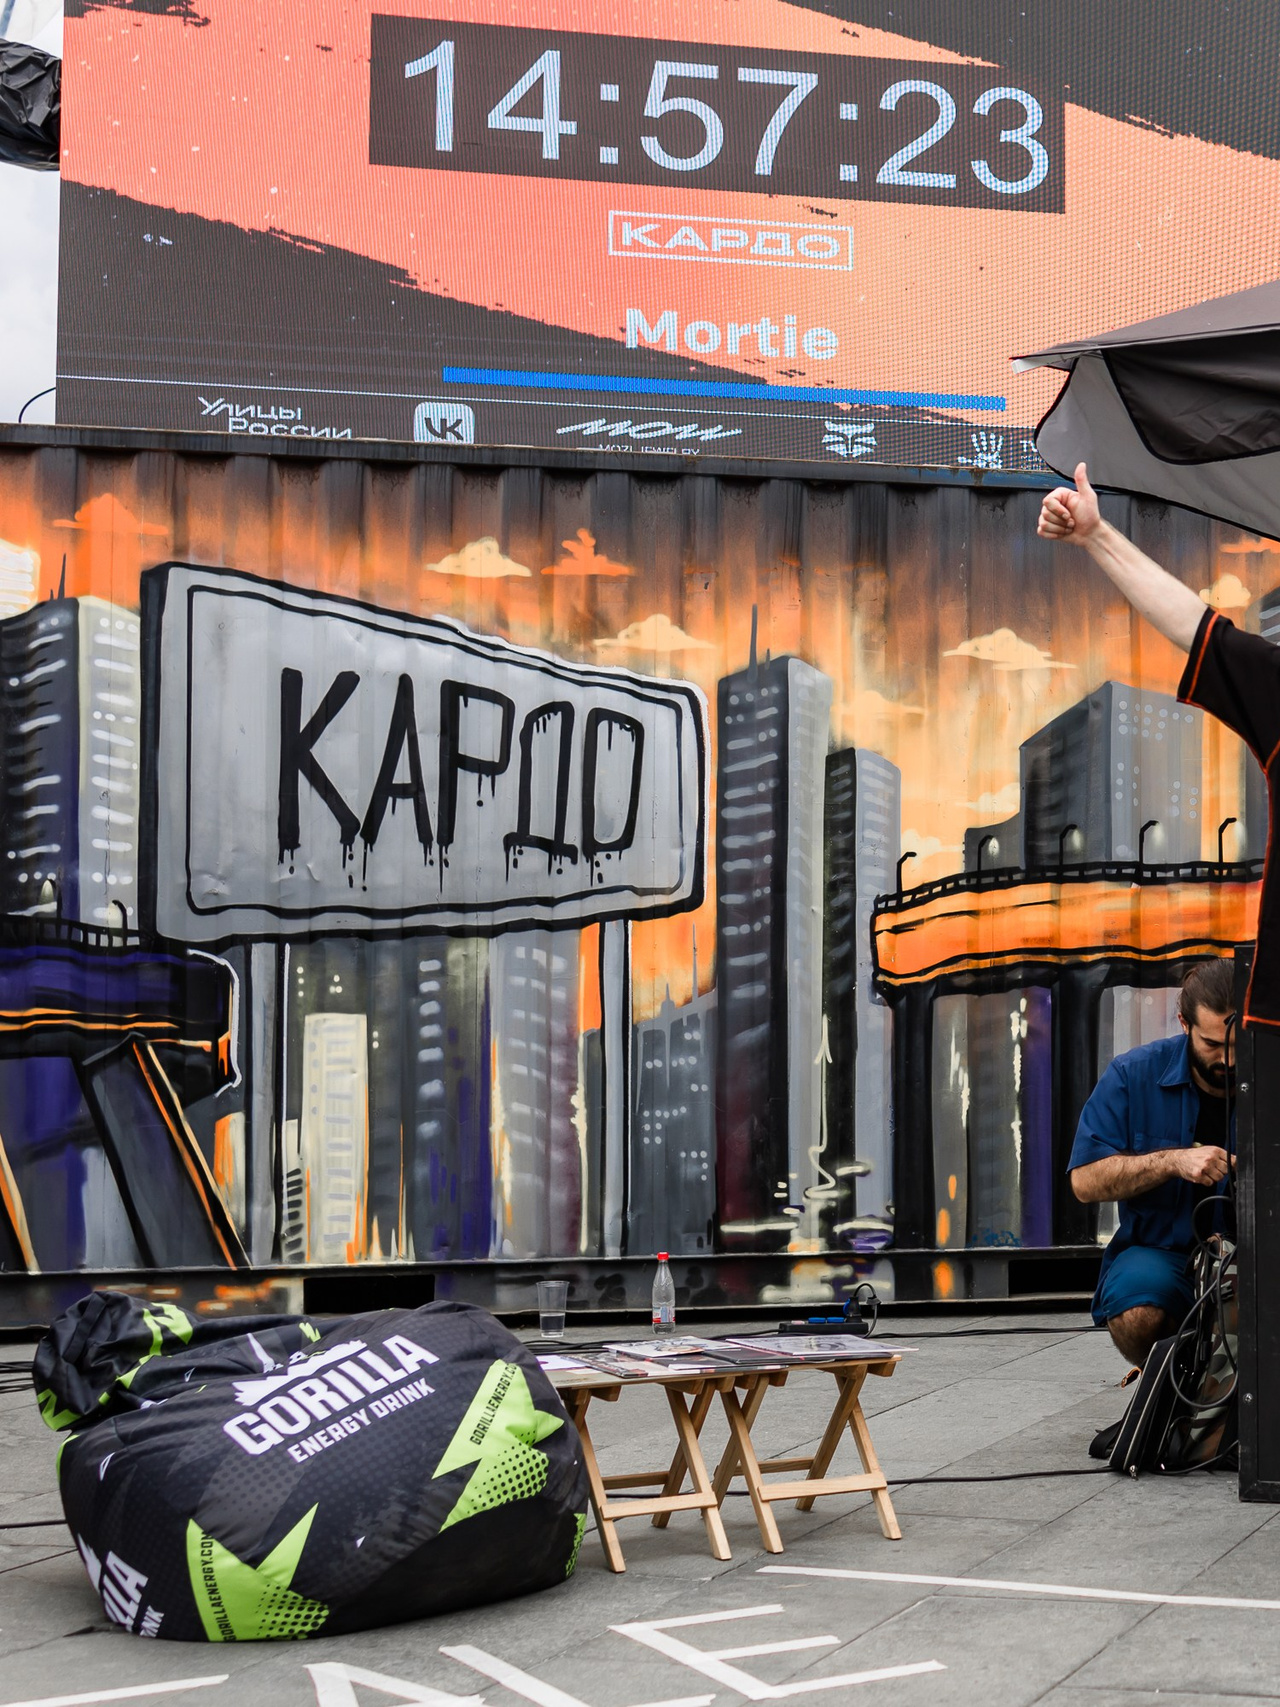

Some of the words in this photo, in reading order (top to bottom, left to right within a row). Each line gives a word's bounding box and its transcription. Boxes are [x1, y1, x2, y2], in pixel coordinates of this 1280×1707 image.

[405, 40, 1049, 194] 14:57:23
[621, 221, 840, 258] КАРДО
[625, 308, 839, 359] Mortie
[198, 396, 302, 420] Улицы
[228, 417, 352, 440] России
[424, 417, 463, 441] VK
[278, 667, 645, 878] КАРДО
[223, 1334, 440, 1455] GORILLA
[287, 1409, 372, 1463] ENERGY
[368, 1378, 436, 1419] DRINK
